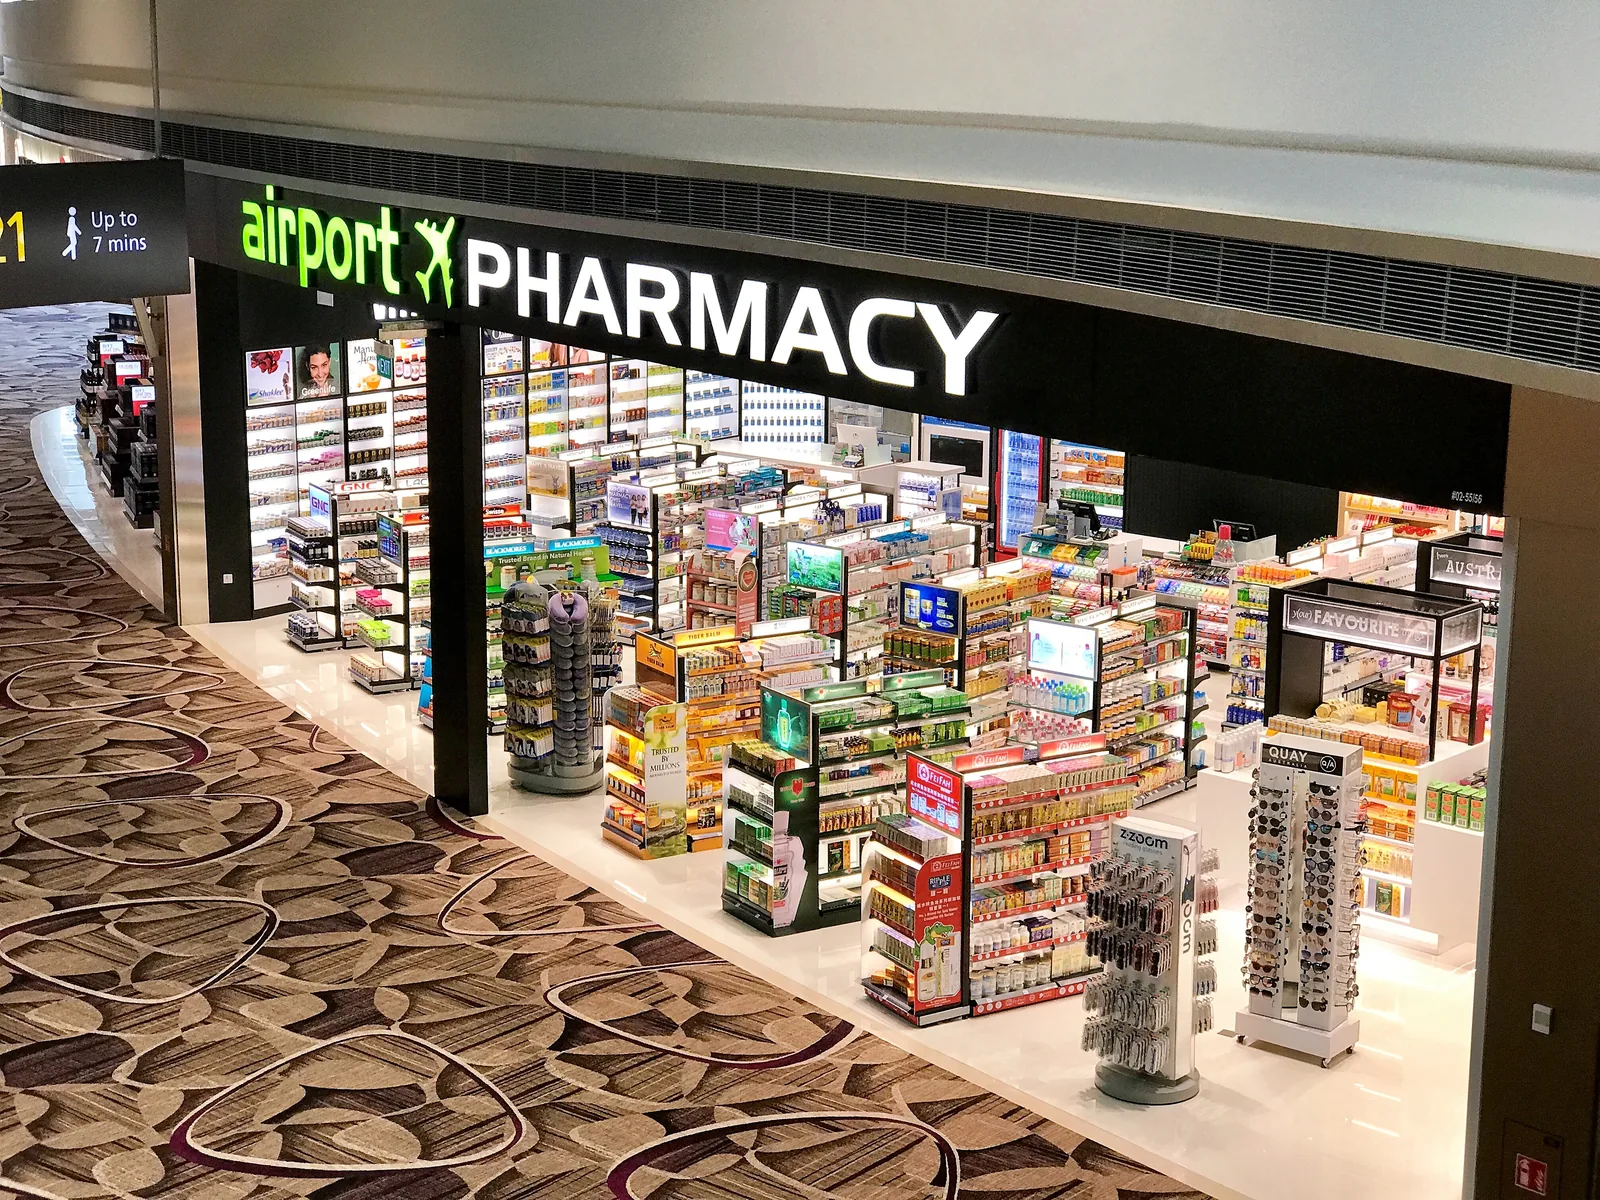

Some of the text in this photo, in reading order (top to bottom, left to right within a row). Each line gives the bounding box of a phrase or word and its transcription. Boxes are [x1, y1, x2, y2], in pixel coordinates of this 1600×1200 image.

[91, 211, 138, 232] Up to
[92, 234, 147, 253] 7 mins
[242, 184, 999, 396] airport PHARMACY
[258, 388, 284, 397] Shaklee
[301, 384, 336, 396] GreenLife
[340, 481, 378, 492] GNC
[311, 496, 329, 514] GNC
[486, 545, 527, 555] BLACKMORES
[554, 539, 595, 549] BLACKMORES
[498, 555, 521, 565] Trusted
[522, 553, 542, 562] Brand
[549, 551, 573, 560] Natural
[1445, 560, 1502, 580] AUSTR
[1314, 609, 1400, 637] FAVOURITE
[651, 746, 679, 756] TRUSTED
[1268, 746, 1308, 762] QUAY
[661, 755, 670, 763] BY
[1268, 758, 1308, 769] AUSTRALIA
[649, 762, 681, 773] MILLIONS
